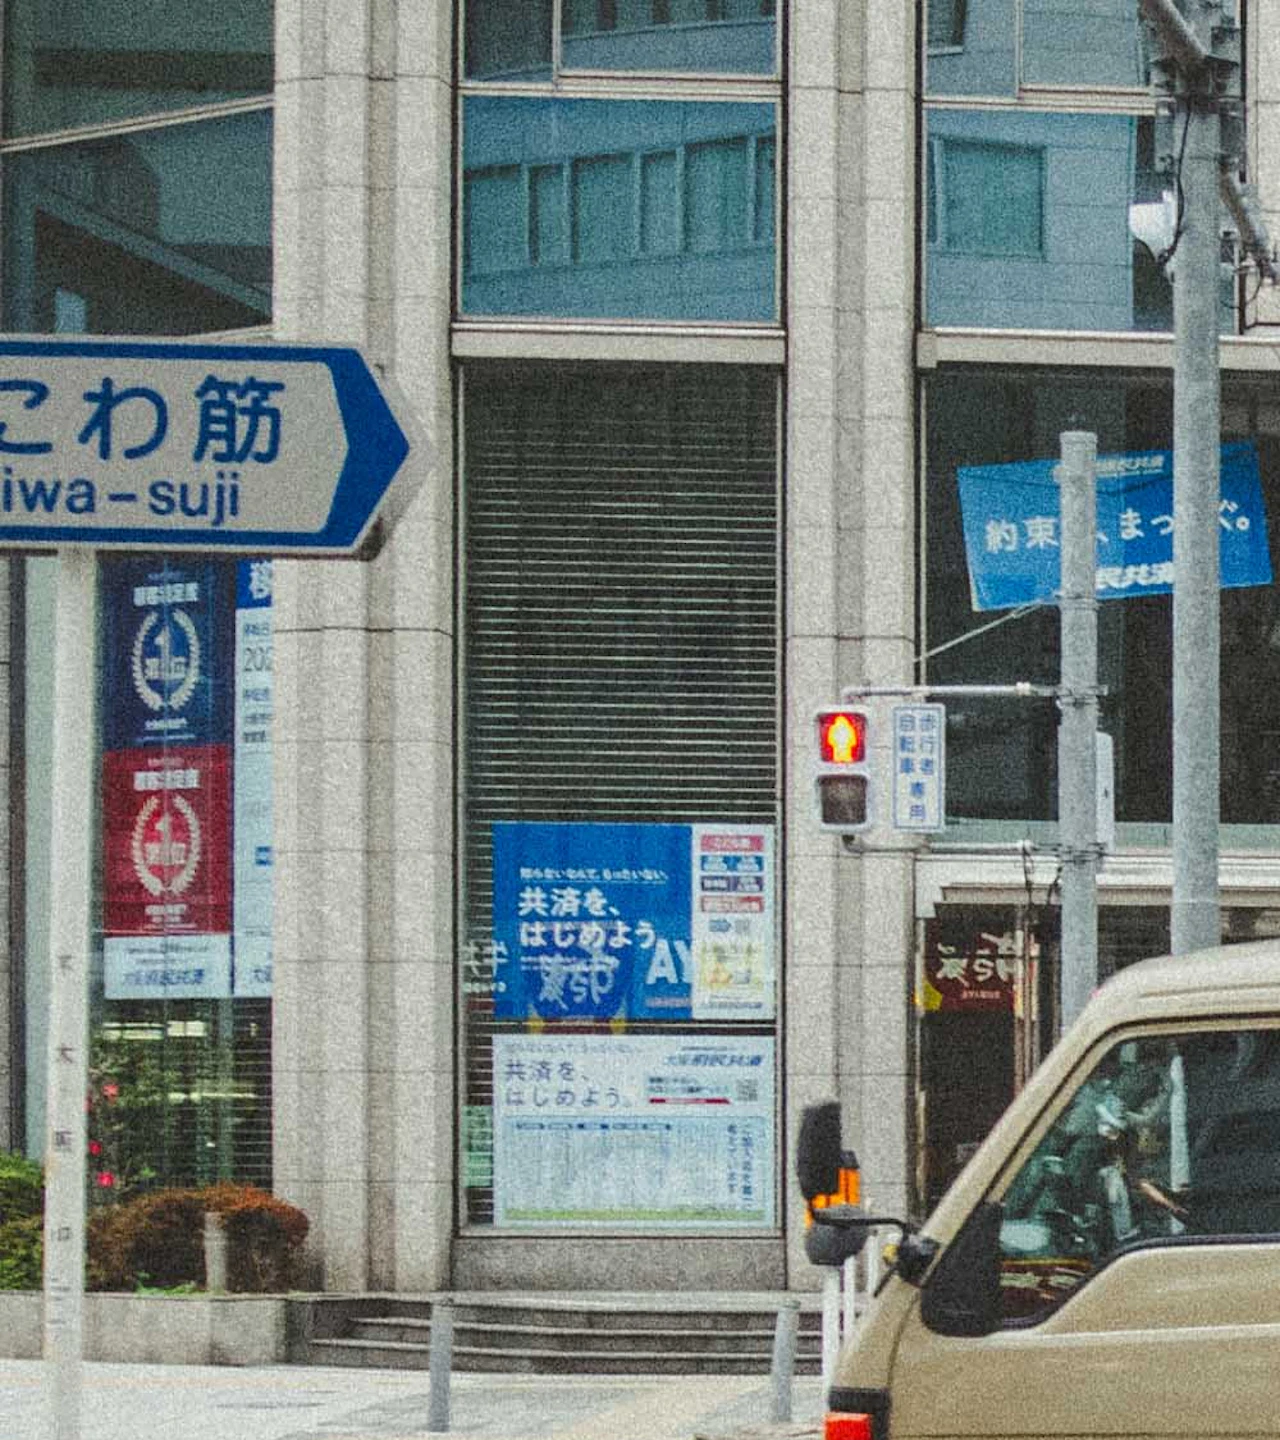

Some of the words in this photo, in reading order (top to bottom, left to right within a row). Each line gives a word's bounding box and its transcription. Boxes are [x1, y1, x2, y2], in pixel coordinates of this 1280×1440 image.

[518, 886, 620, 916] 共済を、
[504, 1060, 589, 1081] 共済を、
[505, 1086, 633, 1108] はじめよう。
